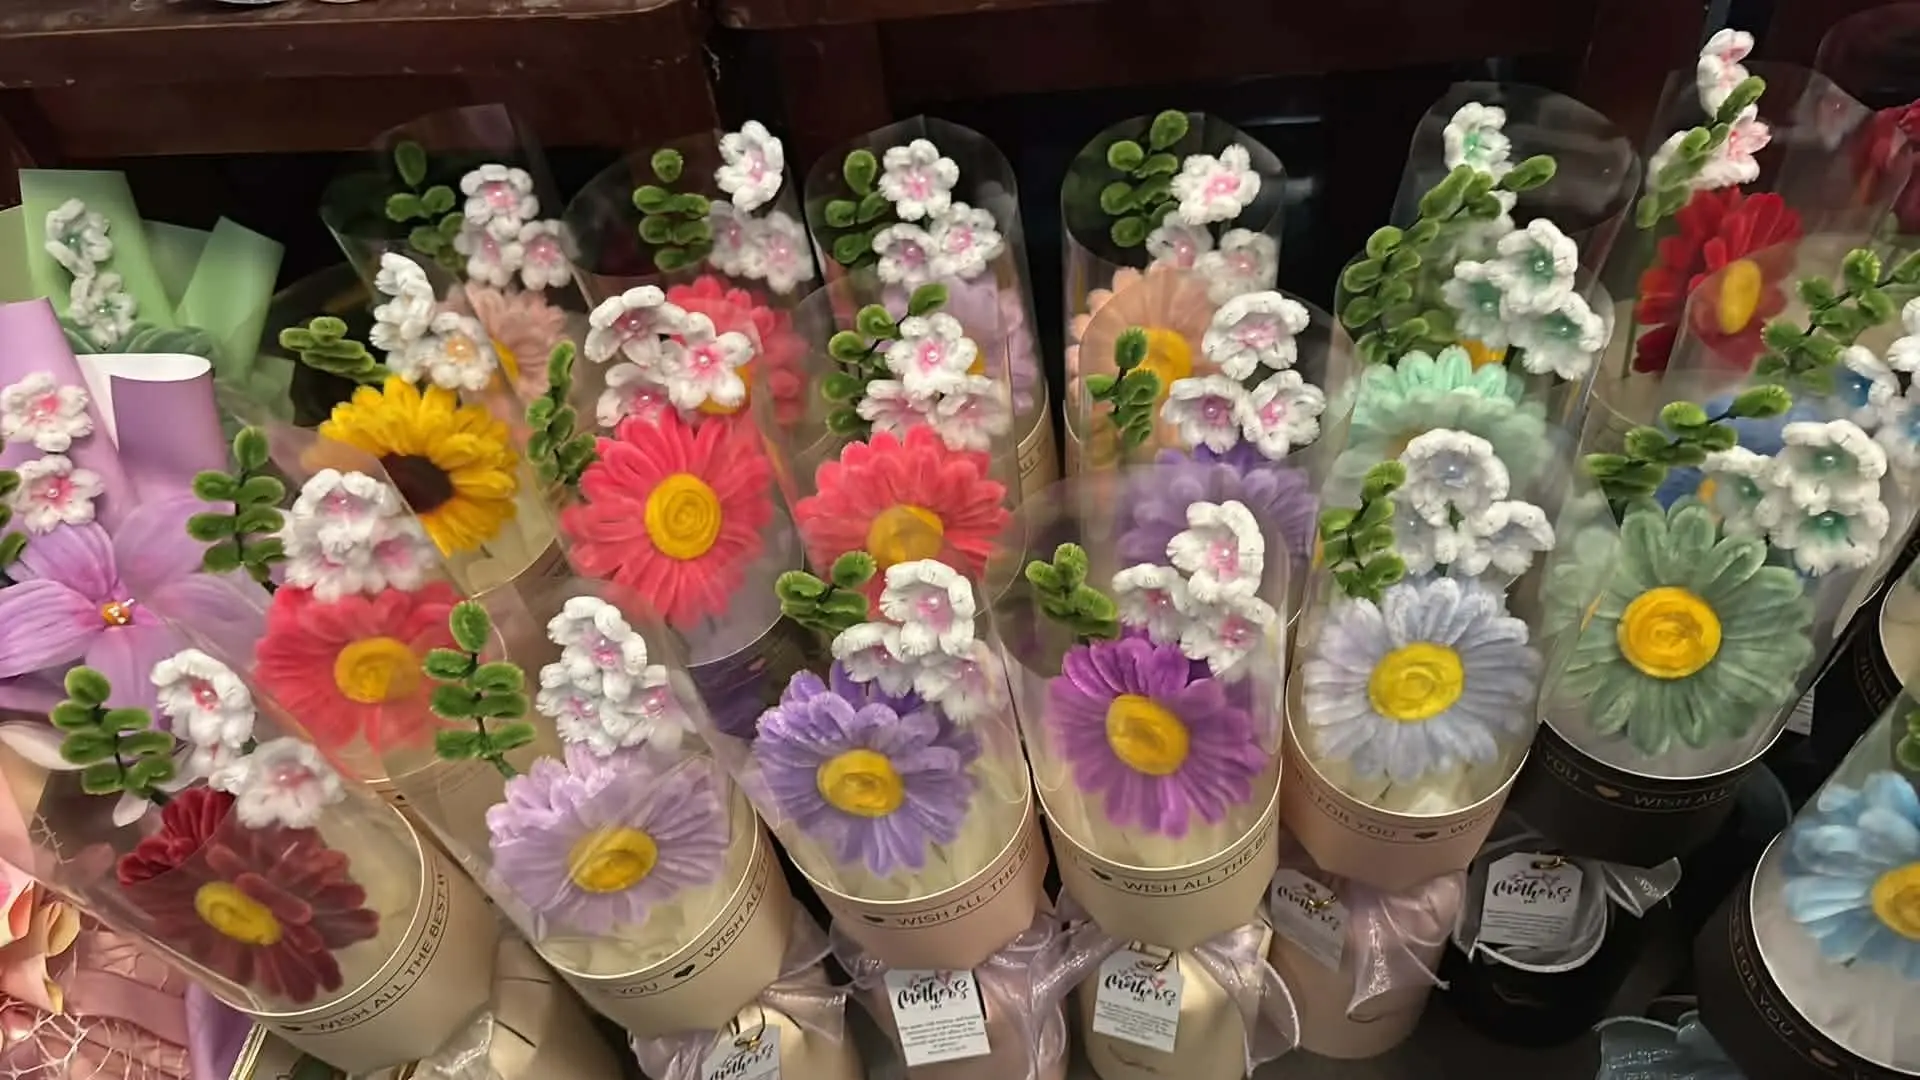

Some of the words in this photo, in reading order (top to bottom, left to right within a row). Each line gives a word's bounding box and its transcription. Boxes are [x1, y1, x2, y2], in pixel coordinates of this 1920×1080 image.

[1545, 752, 1580, 783] YOU
[1633, 793, 1690, 808] WISH
[1357, 821, 1397, 838] YOU
[899, 910, 950, 927] WISH
[955, 894, 987, 914] ALL
[990, 864, 1017, 891] THE
[1123, 881, 1177, 893] WISH
[1184, 876, 1216, 891] ALL
[1221, 851, 1252, 876] THE
[616, 981, 659, 995] YOU
[704, 914, 746, 959] WISH
[746, 882, 763, 914] ALL
[374, 983, 408, 1009] ALL
[404, 941, 431, 977] THE
[1759, 994, 1795, 1036] YOU
